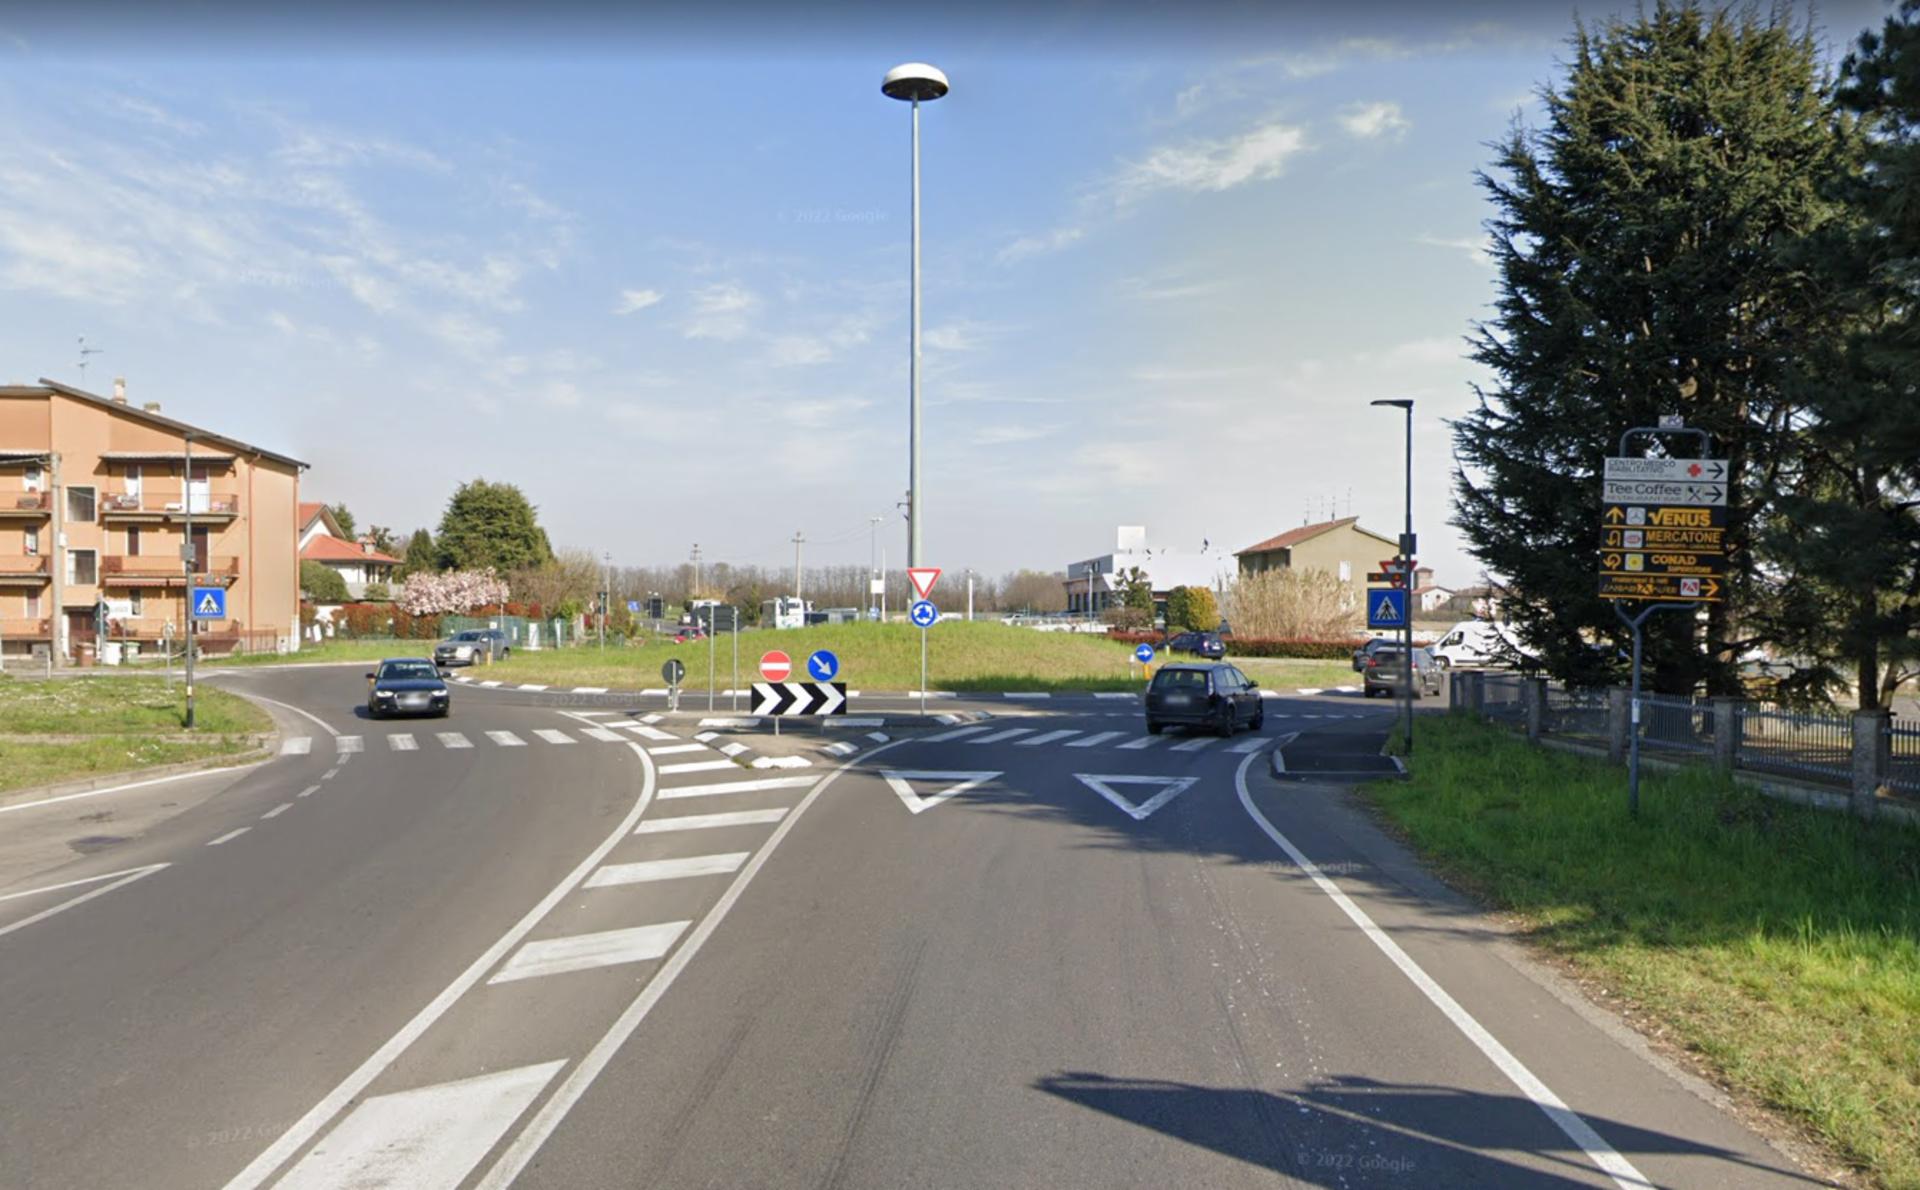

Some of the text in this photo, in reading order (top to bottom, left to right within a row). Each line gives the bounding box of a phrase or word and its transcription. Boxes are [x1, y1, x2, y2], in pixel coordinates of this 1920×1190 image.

[1607, 483, 1682, 495] Tee Coffee
[1648, 508, 1711, 527] VENUS
[1646, 530, 1720, 543] MERCATONE
[1651, 555, 1697, 565] CONAD
